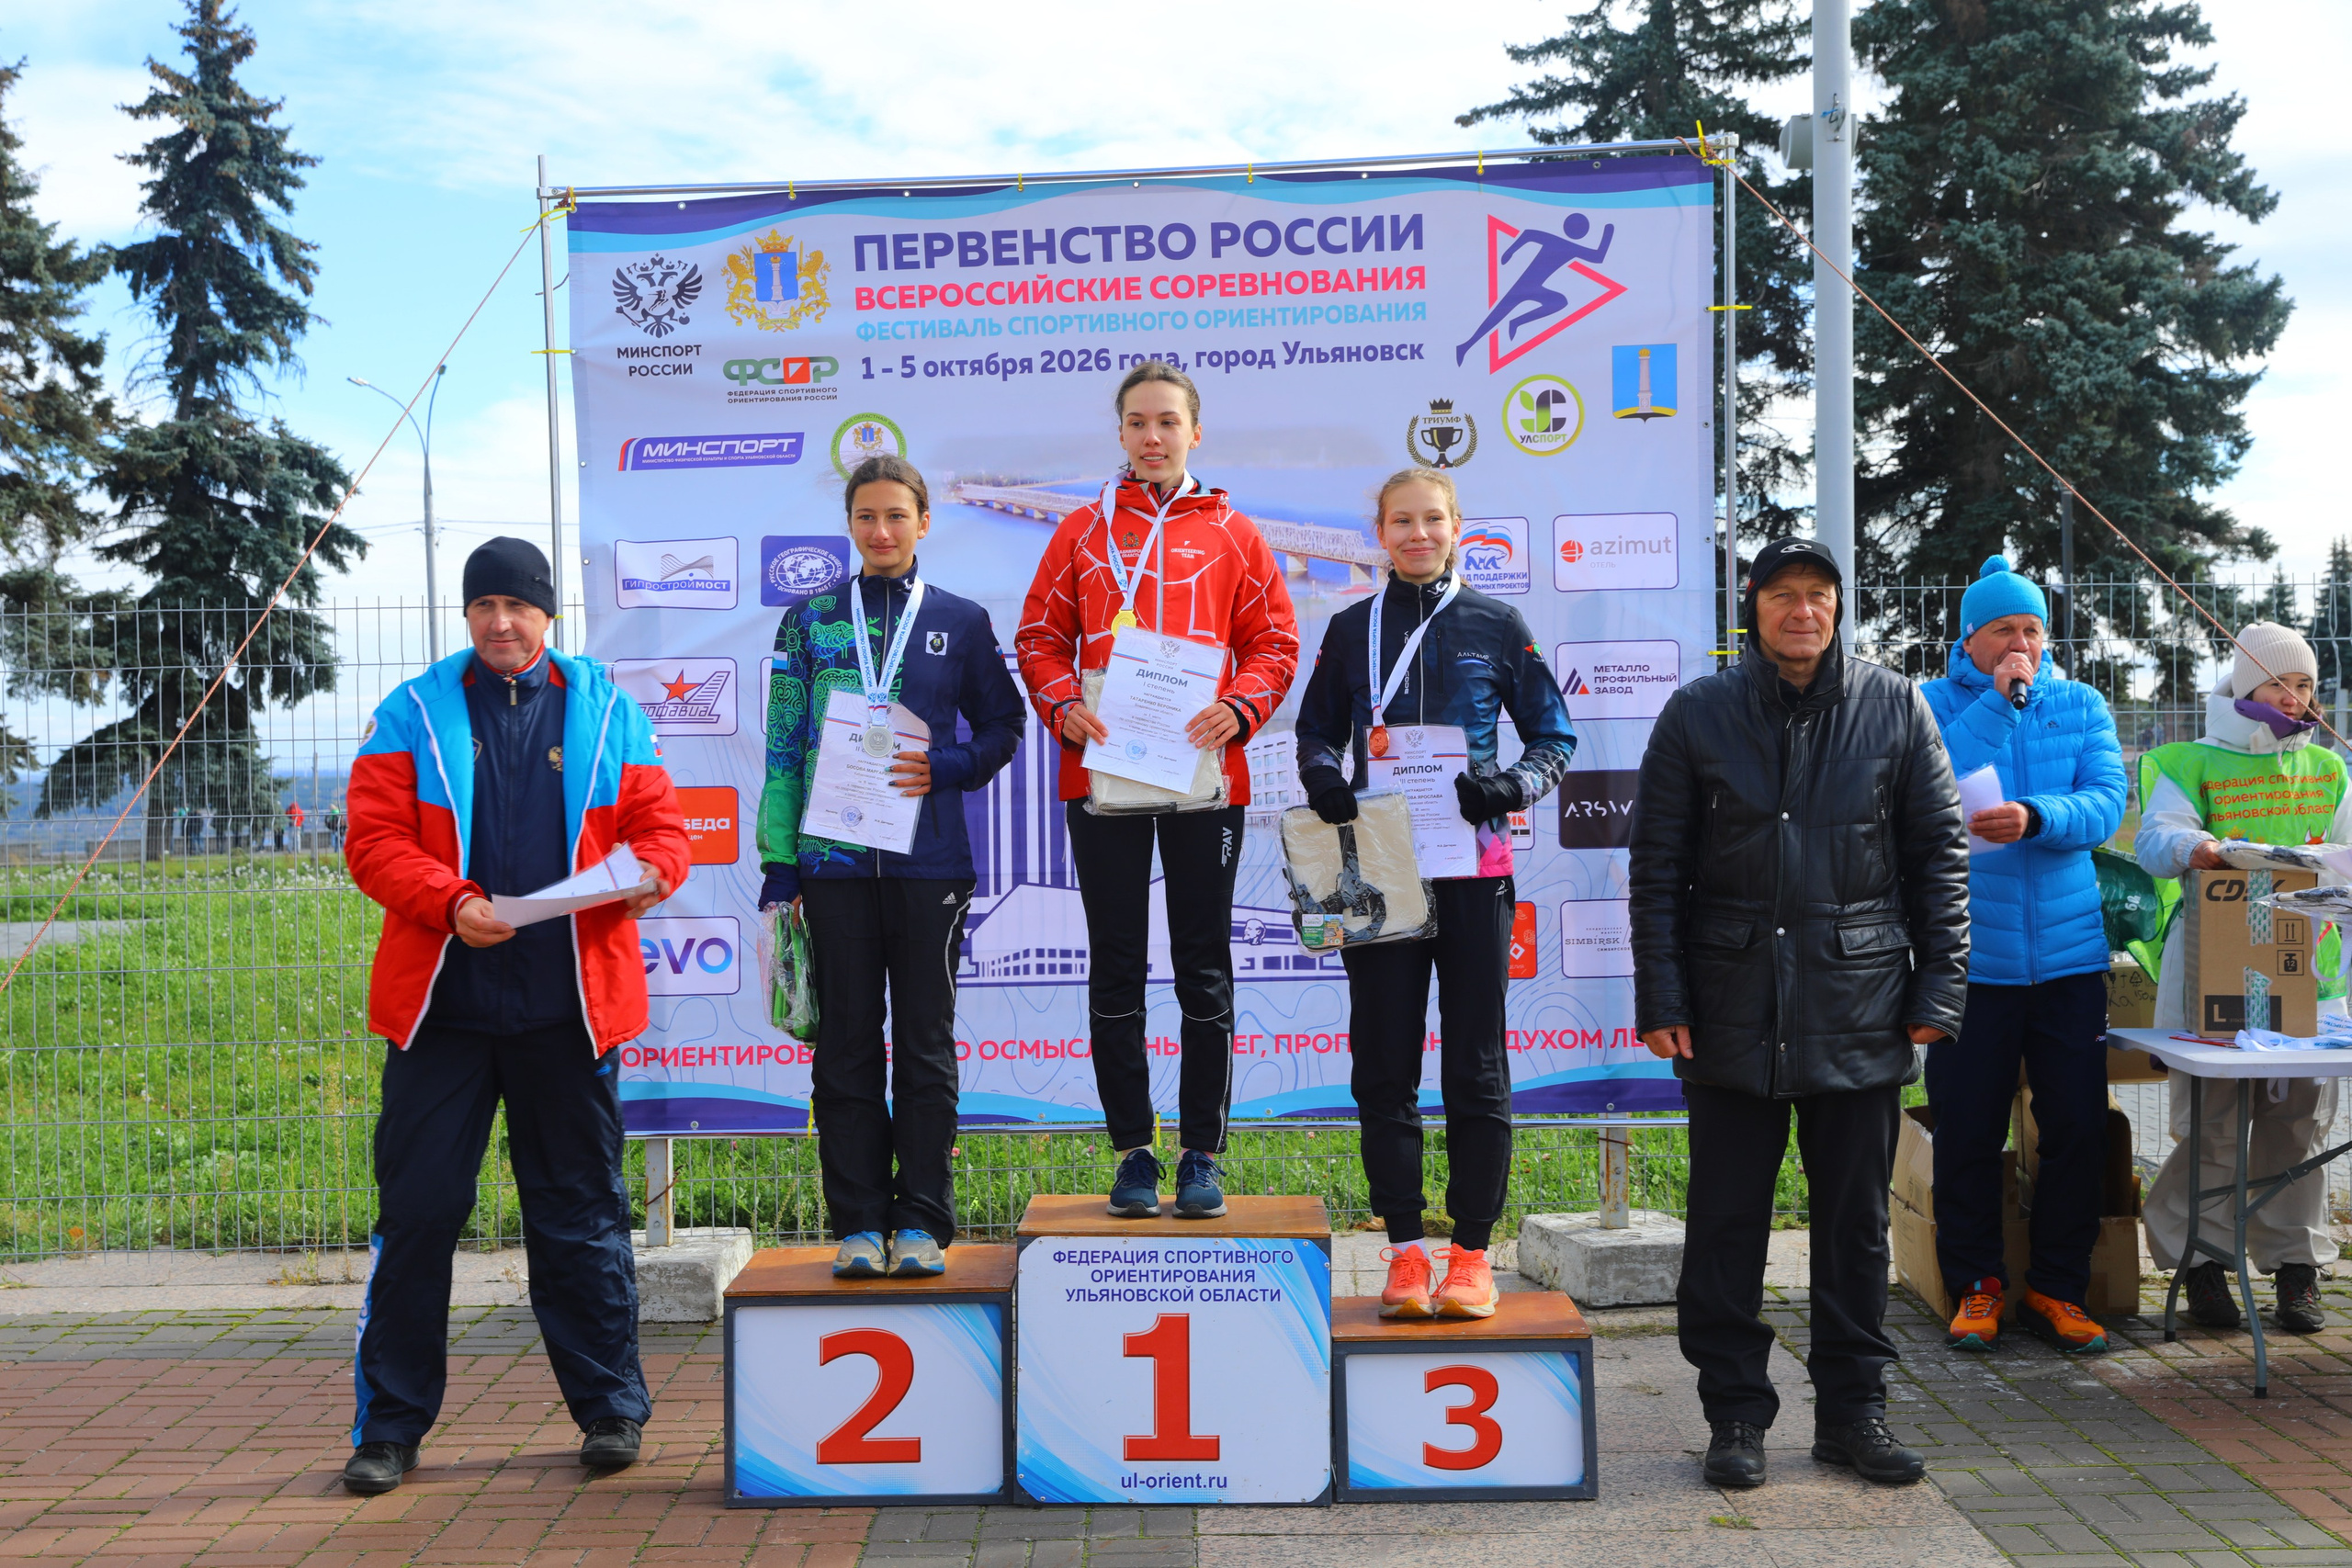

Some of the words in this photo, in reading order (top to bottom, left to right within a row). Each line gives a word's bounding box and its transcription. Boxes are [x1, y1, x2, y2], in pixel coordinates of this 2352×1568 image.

[854, 222, 1196, 272] ПЕРВЕНСТВО
[1210, 213, 1424, 259] РОССИИ
[854, 273, 1142, 310] ВСЕРОССИЙСКИЕ
[1149, 265, 1426, 300] СОРЕВНОВАНИЯ
[855, 318, 1003, 342] ФЕСТИВАЛЬ
[1008, 310, 1189, 335] СПОРТИВНОГО
[1193, 301, 1427, 330] ОРИЕНТИРОВАНИЯ
[616, 344, 702, 359] МИНСПОРТ
[628, 363, 693, 377] РОССИИ
[861, 356, 875, 379] 1
[900, 355, 917, 378] 5
[922, 352, 1034, 382] октября
[1040, 347, 1112, 374] 2026
[1195, 347, 1276, 374] город
[1282, 341, 1425, 366] Ульяновск
[727, 389, 776, 397] ФЕДЕРАЦИЯ
[778, 387, 838, 395] СПОРТИВНОГО
[727, 396, 802, 404] ОРИЕНТИРОВАНИЯ
[1422, 416, 1462, 425] ТРИУМФ
[1519, 433, 1567, 444] УЛСПОРТ
[642, 438, 797, 457] МИНСПОРТ
[1170, 547, 1205, 556] ORIENTEERING
[1589, 536, 1672, 555] azimut
[769, 557, 780, 583] РУССКОЕ
[777, 547, 829, 560] ГЕОГРАФИЧЕСКОЕ
[828, 554, 842, 579] ОБЩЕСТВО
[1473, 572, 1528, 582] ПОДДЕРЖКИ
[777, 585, 808, 595] ОСНОВАНО
[1594, 664, 1650, 673] МЕТАЛЛО
[1136, 668, 1189, 688] ДИПЛОМ
[1594, 672, 1678, 684] ПРОФИЛЬНЫЙ
[1146, 683, 1176, 694] степень
[1594, 686, 1634, 695] ЗАВОД
[849, 732, 901, 751] ДИМ
[1392, 764, 1443, 776] ДИПЛОМ
[2213, 1004, 2227, 1022] L
[1233, 1034, 1267, 1058] ЕГ,
[1506, 1028, 1603, 1055] ДУХОМ
[1610, 1027, 1645, 1049] ЛЕ
[1053, 1250, 1159, 1266] ФЕДЕРАЦИЯ
[1164, 1249, 1294, 1264] СПОРТИВНОГО
[1091, 1269, 1256, 1283] ОРИЕНТИРОВАНИЯ
[1066, 1285, 1194, 1303] УЛЬЯНОВСКОЙ
[1199, 1288, 1282, 1303] ОБЛАСТИ
[816, 1326, 922, 1465] 2
[1123, 1313, 1221, 1461] 1
[1422, 1364, 1503, 1471] 3
[1120, 1472, 1227, 1491] ul-orient.ru
